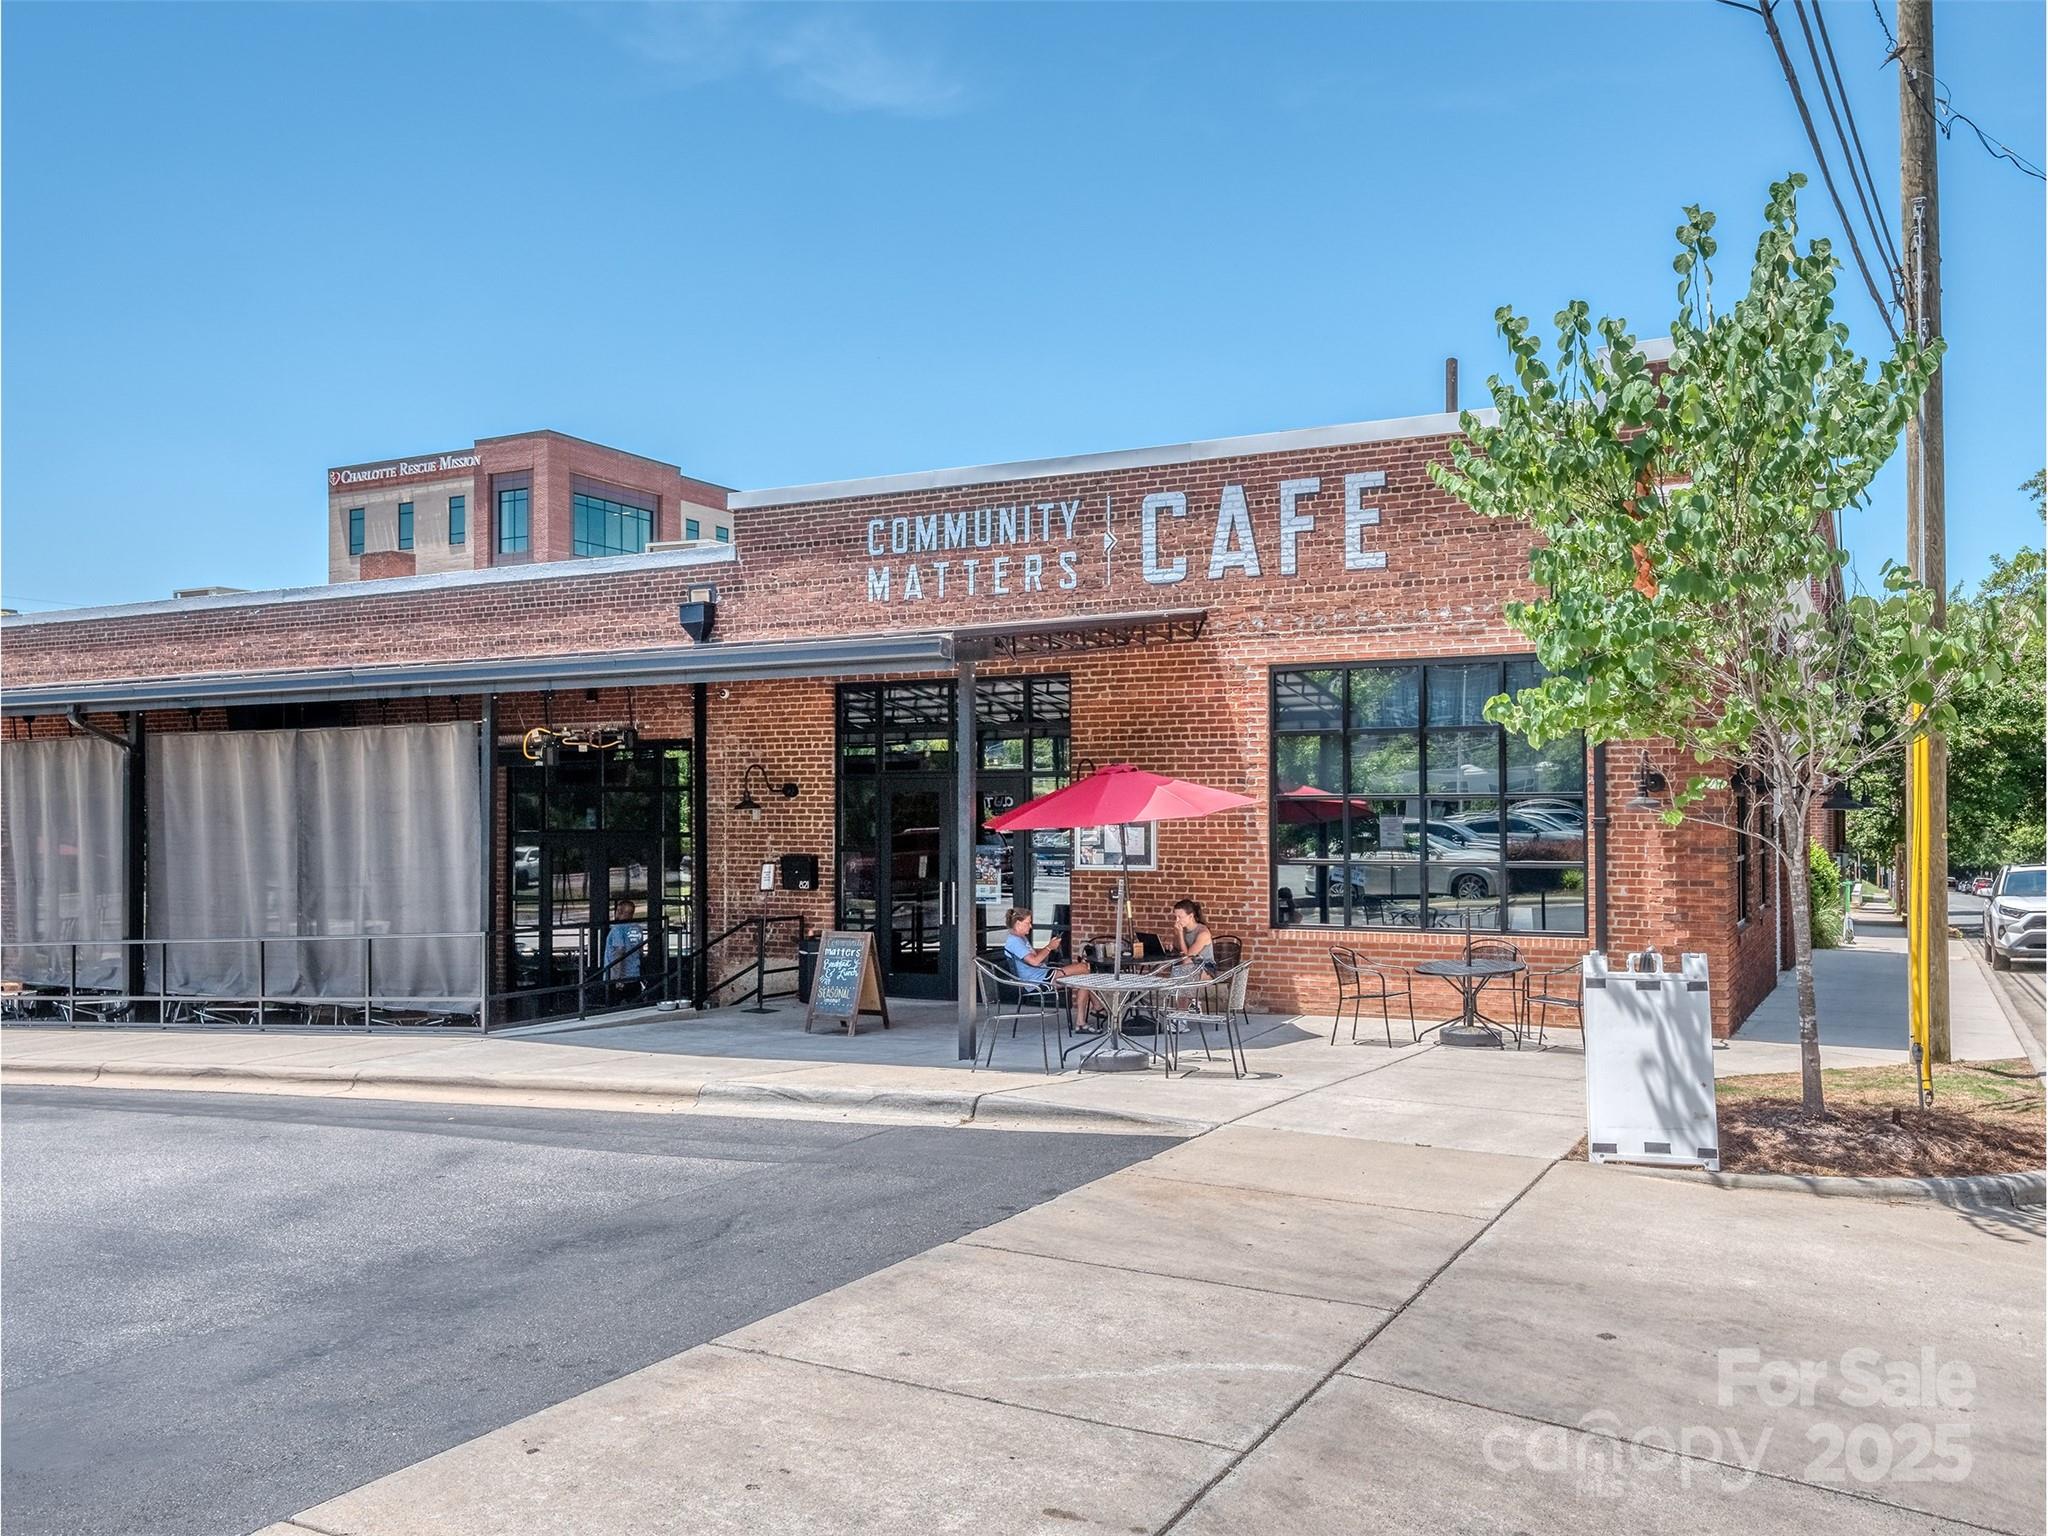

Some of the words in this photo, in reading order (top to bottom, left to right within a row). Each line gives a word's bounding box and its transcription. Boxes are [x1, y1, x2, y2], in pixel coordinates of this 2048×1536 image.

[868, 500, 1081, 557] COMMUNITY
[1141, 471, 1389, 585] CAFE
[868, 551, 1079, 603] MATTERS
[817, 988, 850, 1000] SEASONAL
